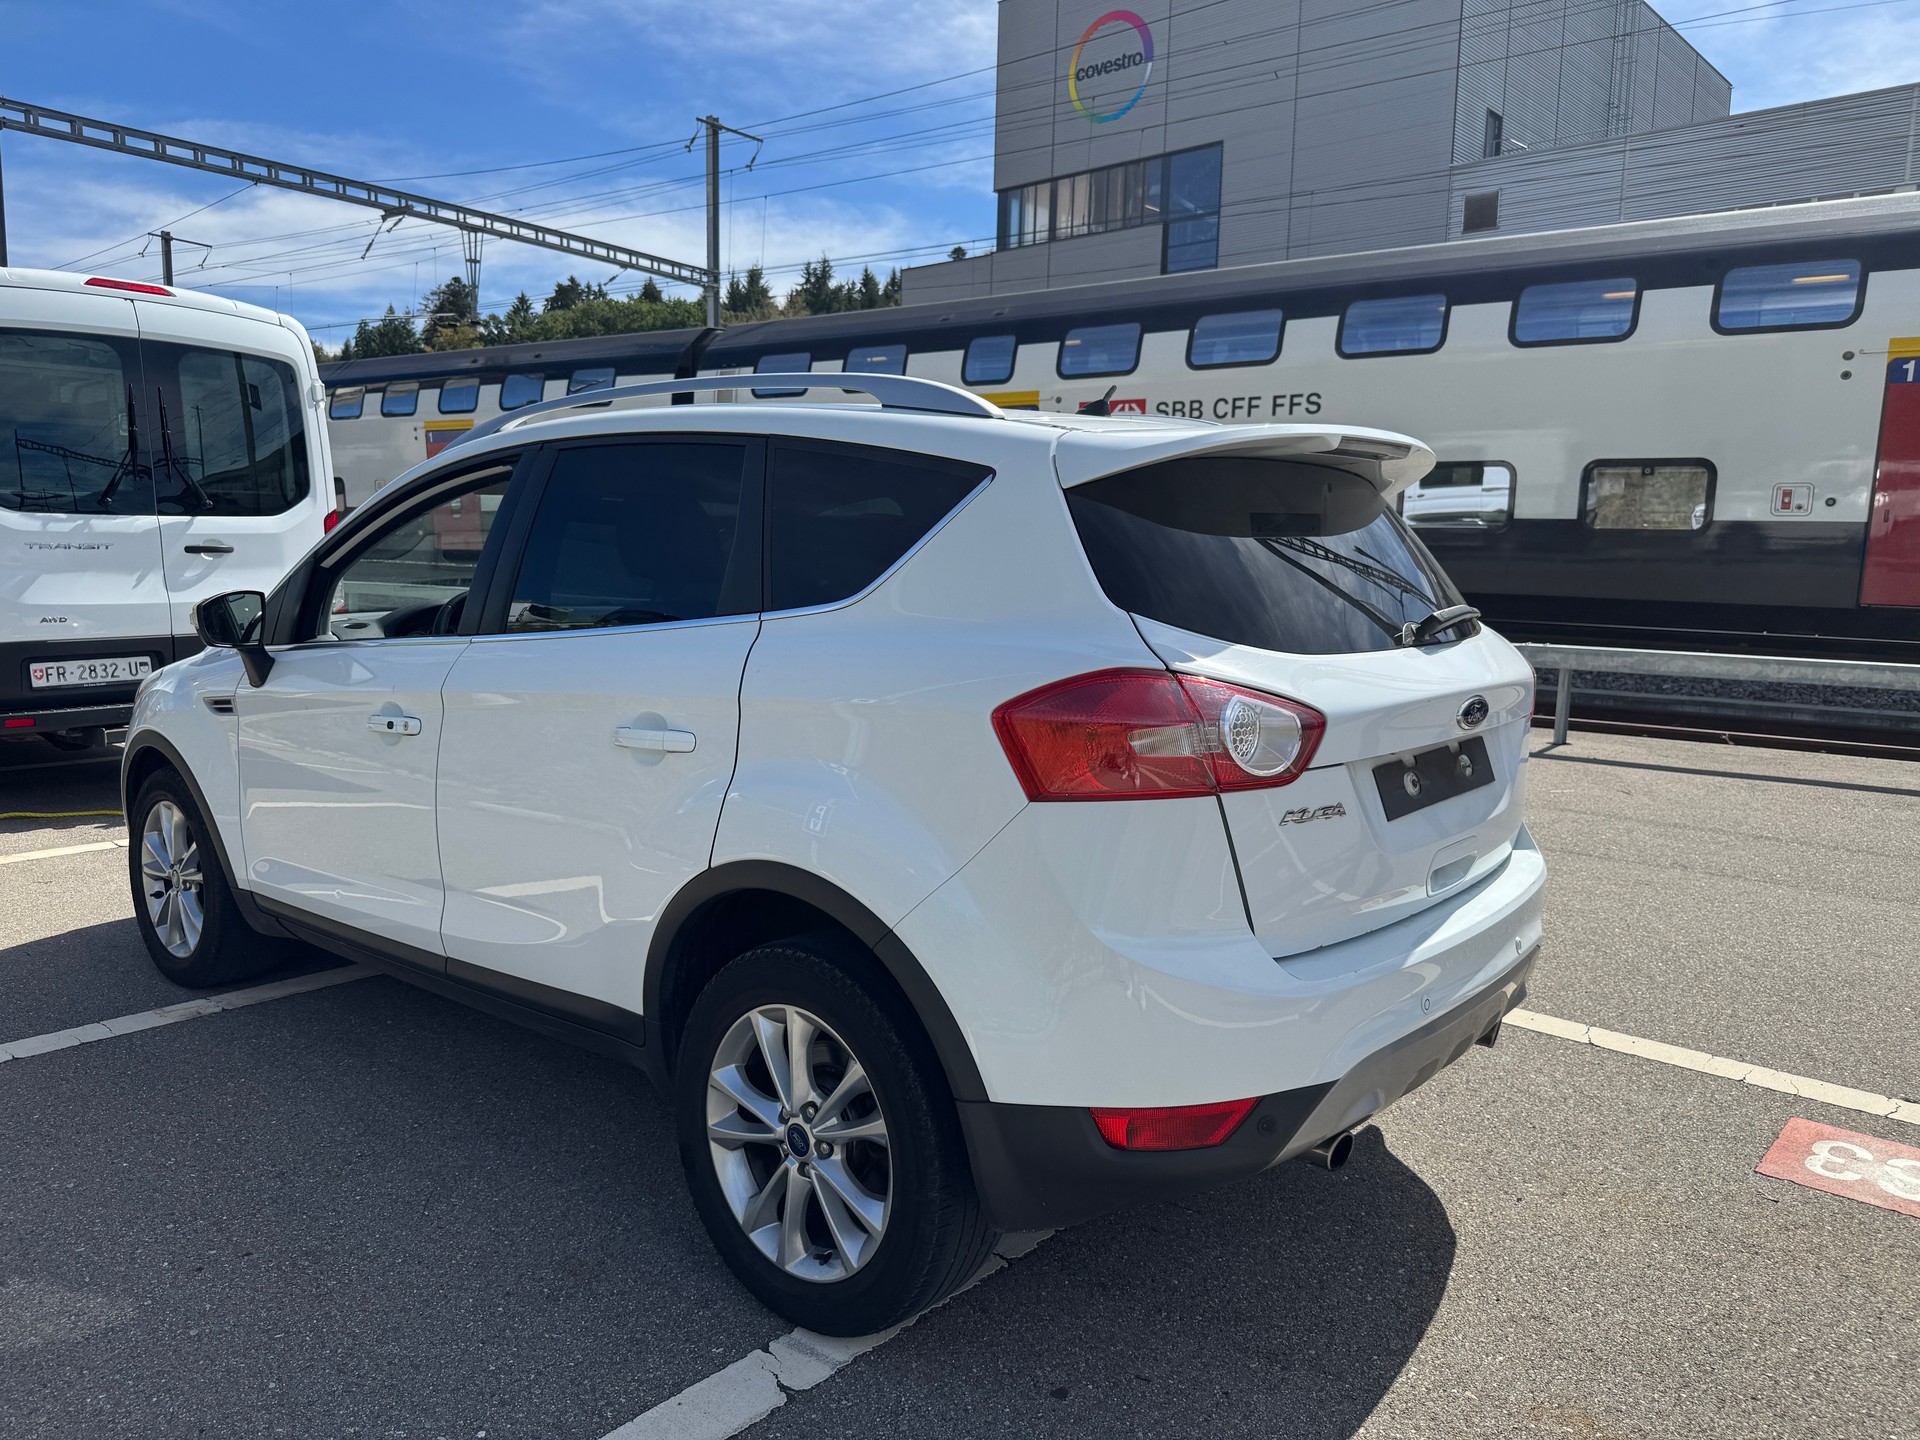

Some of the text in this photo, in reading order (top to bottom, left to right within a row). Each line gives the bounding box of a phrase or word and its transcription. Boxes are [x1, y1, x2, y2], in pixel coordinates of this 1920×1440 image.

[1076, 52, 1143, 82] covestro
[1902, 360, 1916, 382] 1
[1156, 392, 1322, 420] SBB CFF FFS
[24, 542, 114, 550] TRANSIT
[40, 616, 67, 624] AWD
[1279, 801, 1347, 826] KUGA
